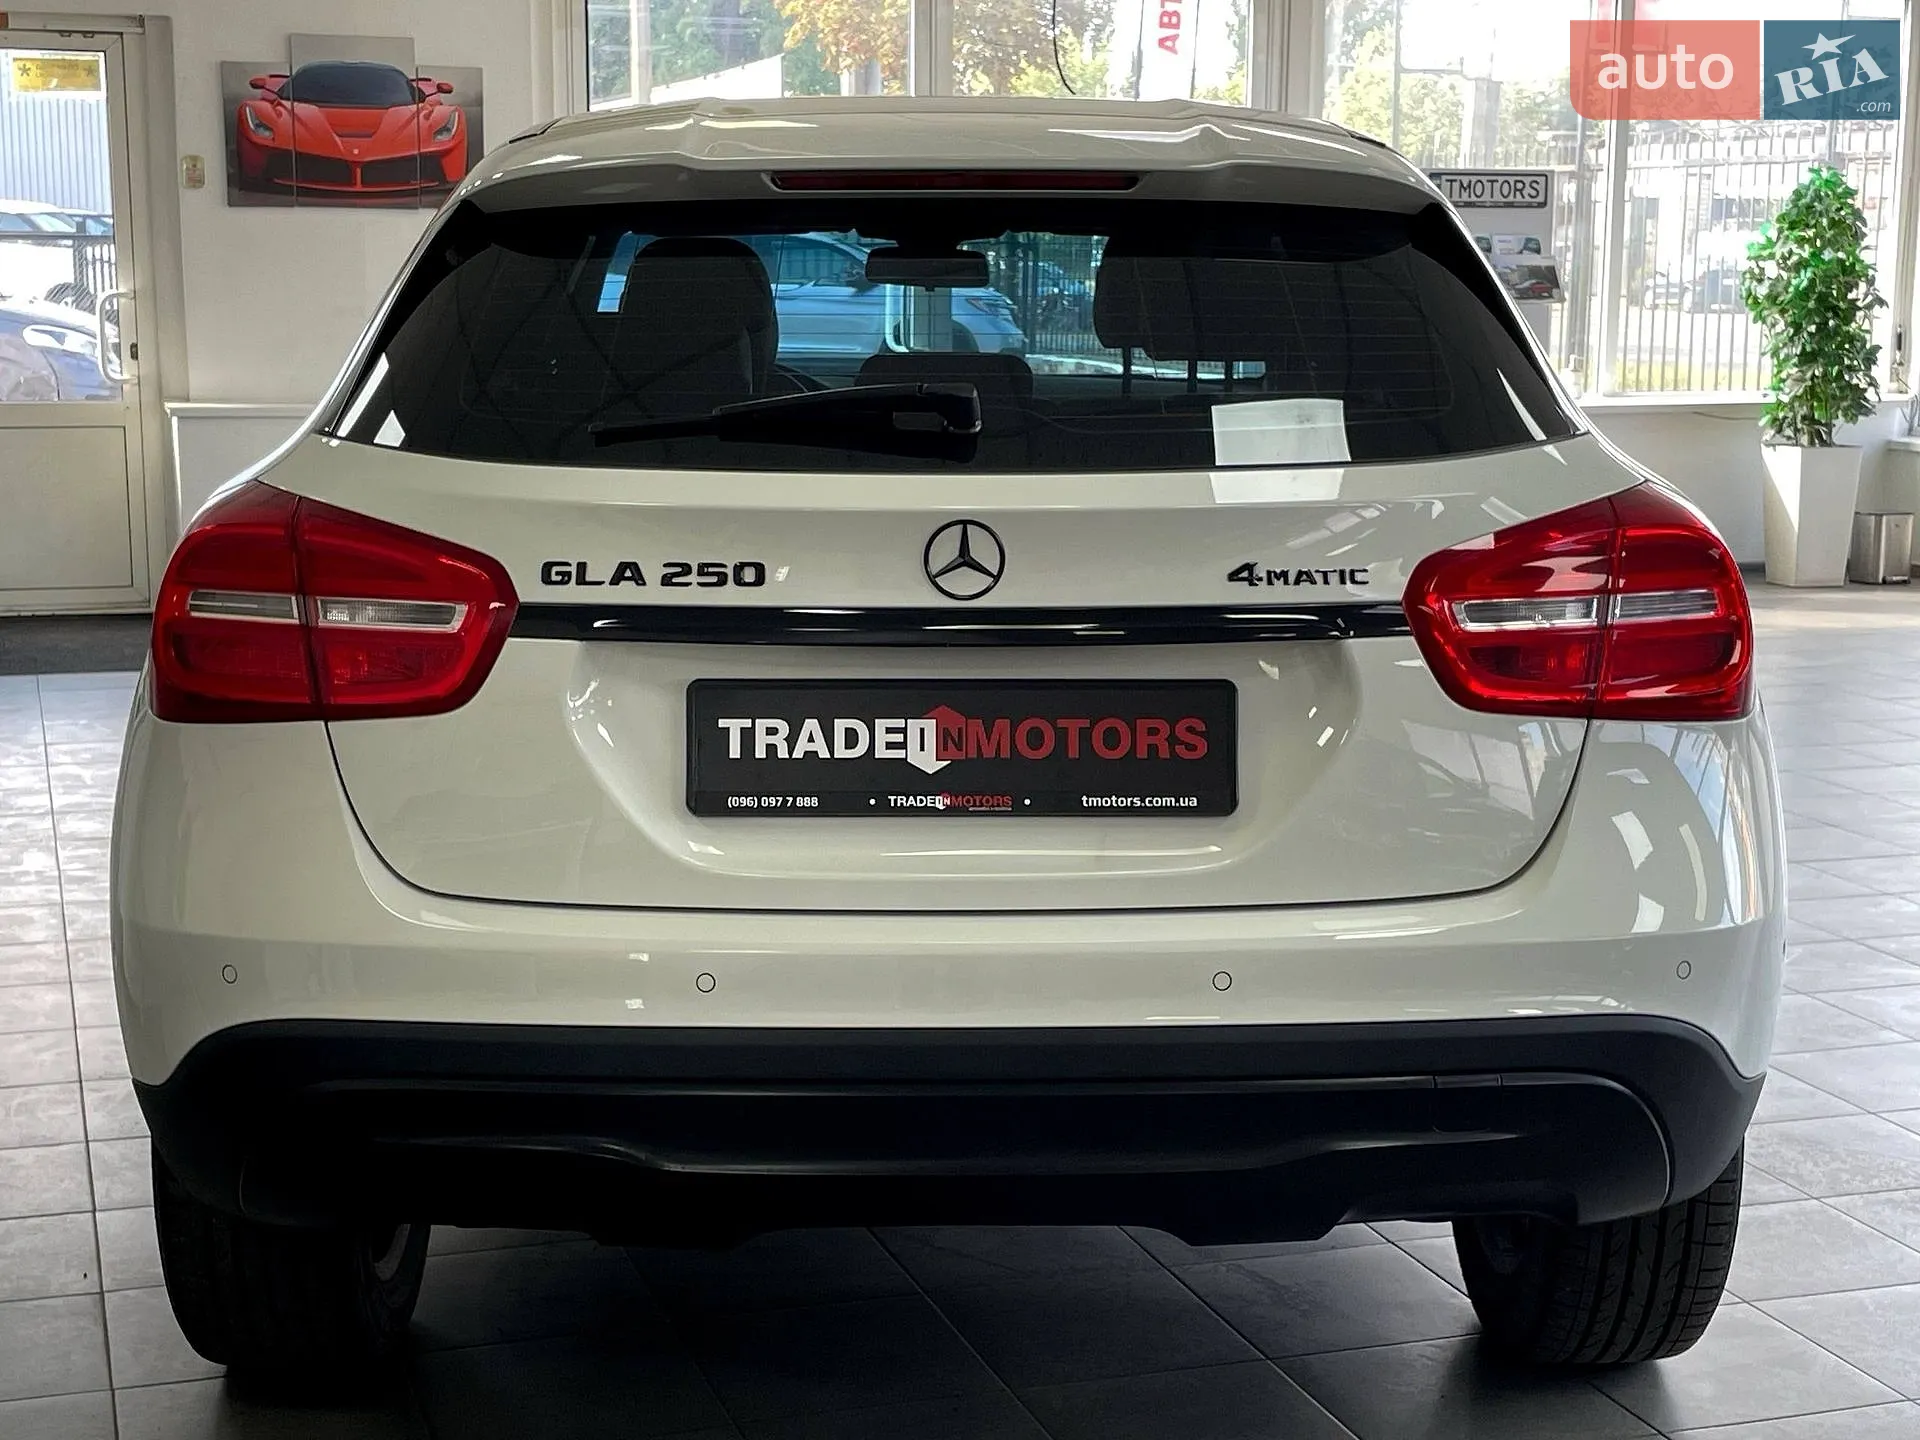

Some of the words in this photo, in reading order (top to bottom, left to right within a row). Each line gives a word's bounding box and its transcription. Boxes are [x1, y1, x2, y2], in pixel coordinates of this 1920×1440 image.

[1445, 178, 1540, 199] TMOTORS
[541, 561, 647, 586] GLA
[660, 562, 766, 587] 250
[1227, 561, 1369, 587] 4MATIC
[727, 796, 758, 808] (096)
[761, 797, 783, 807] 097
[786, 797, 794, 807] 7
[796, 797, 819, 807] 888
[1081, 795, 1198, 807] tmotors.com.ua
